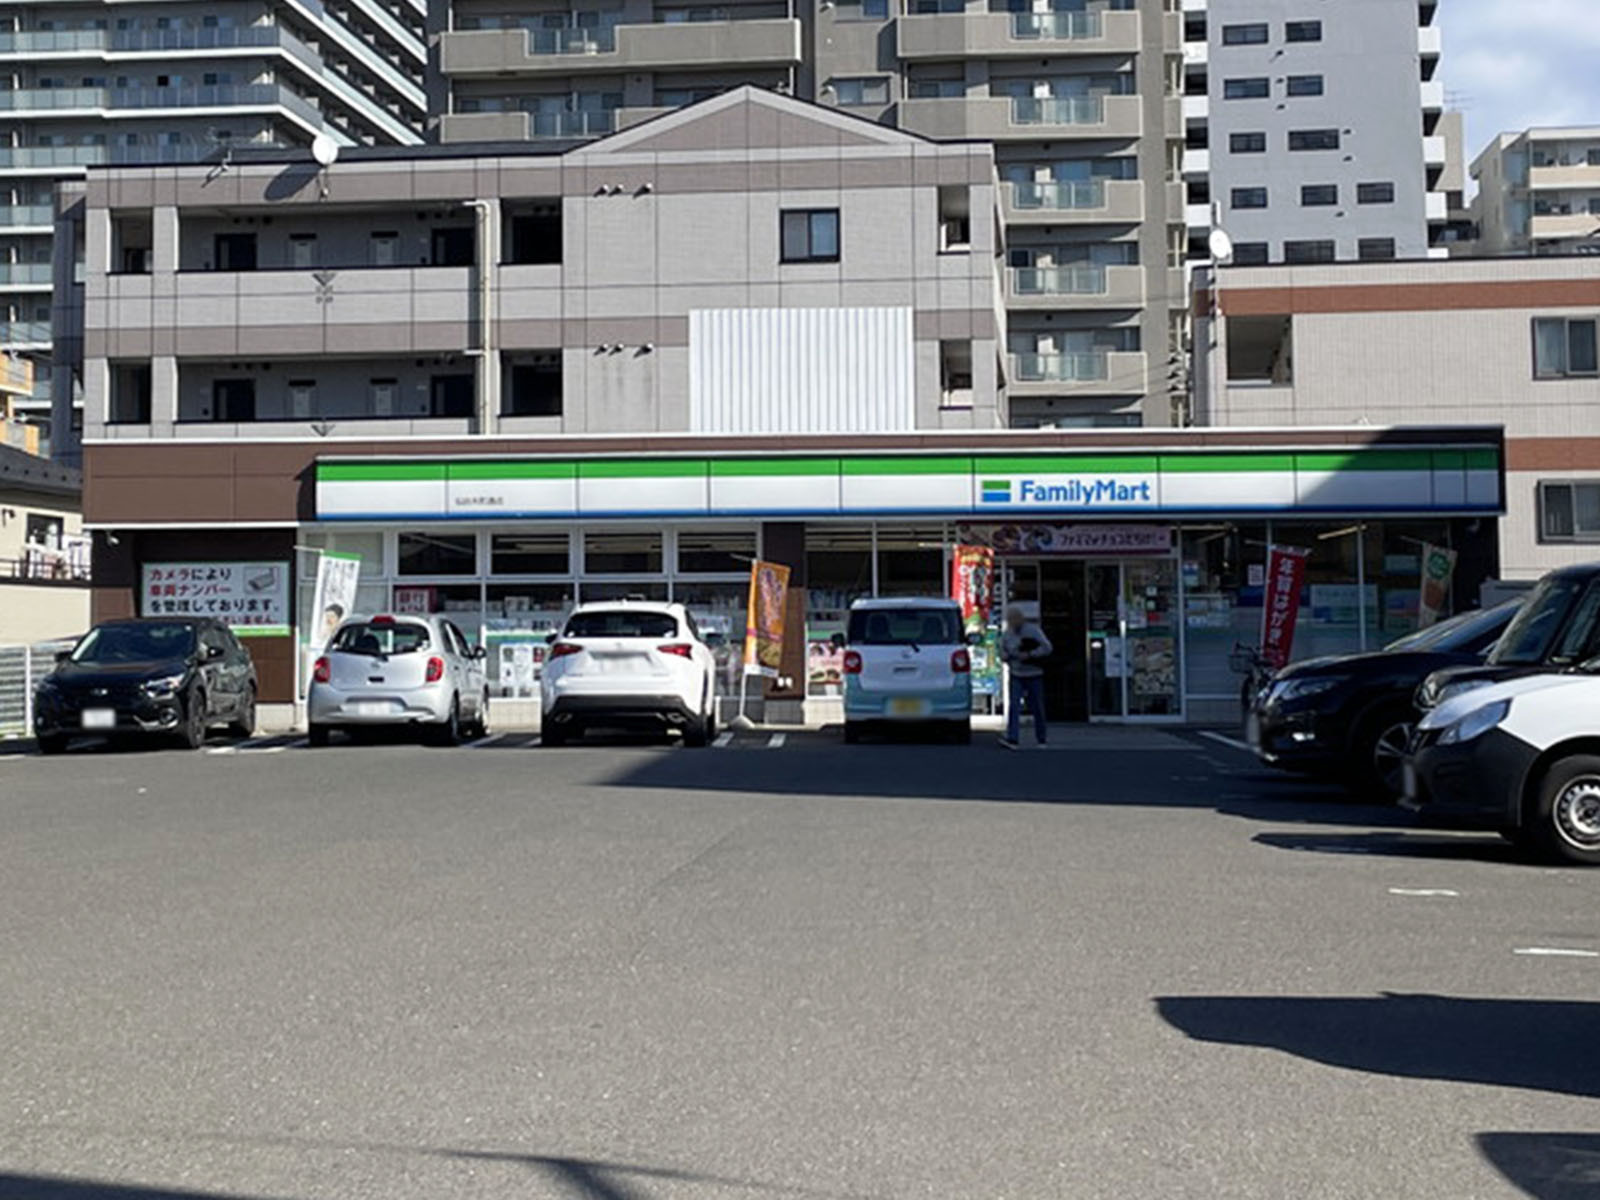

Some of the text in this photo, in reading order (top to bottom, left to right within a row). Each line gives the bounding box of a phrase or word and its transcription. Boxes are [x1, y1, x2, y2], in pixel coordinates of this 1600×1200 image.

[1020, 480, 1150, 505] FamilyMart
[151, 568, 232, 581] カメラにより
[151, 584, 232, 596] 車両ナンバー
[151, 599, 280, 613] を管理しております。
